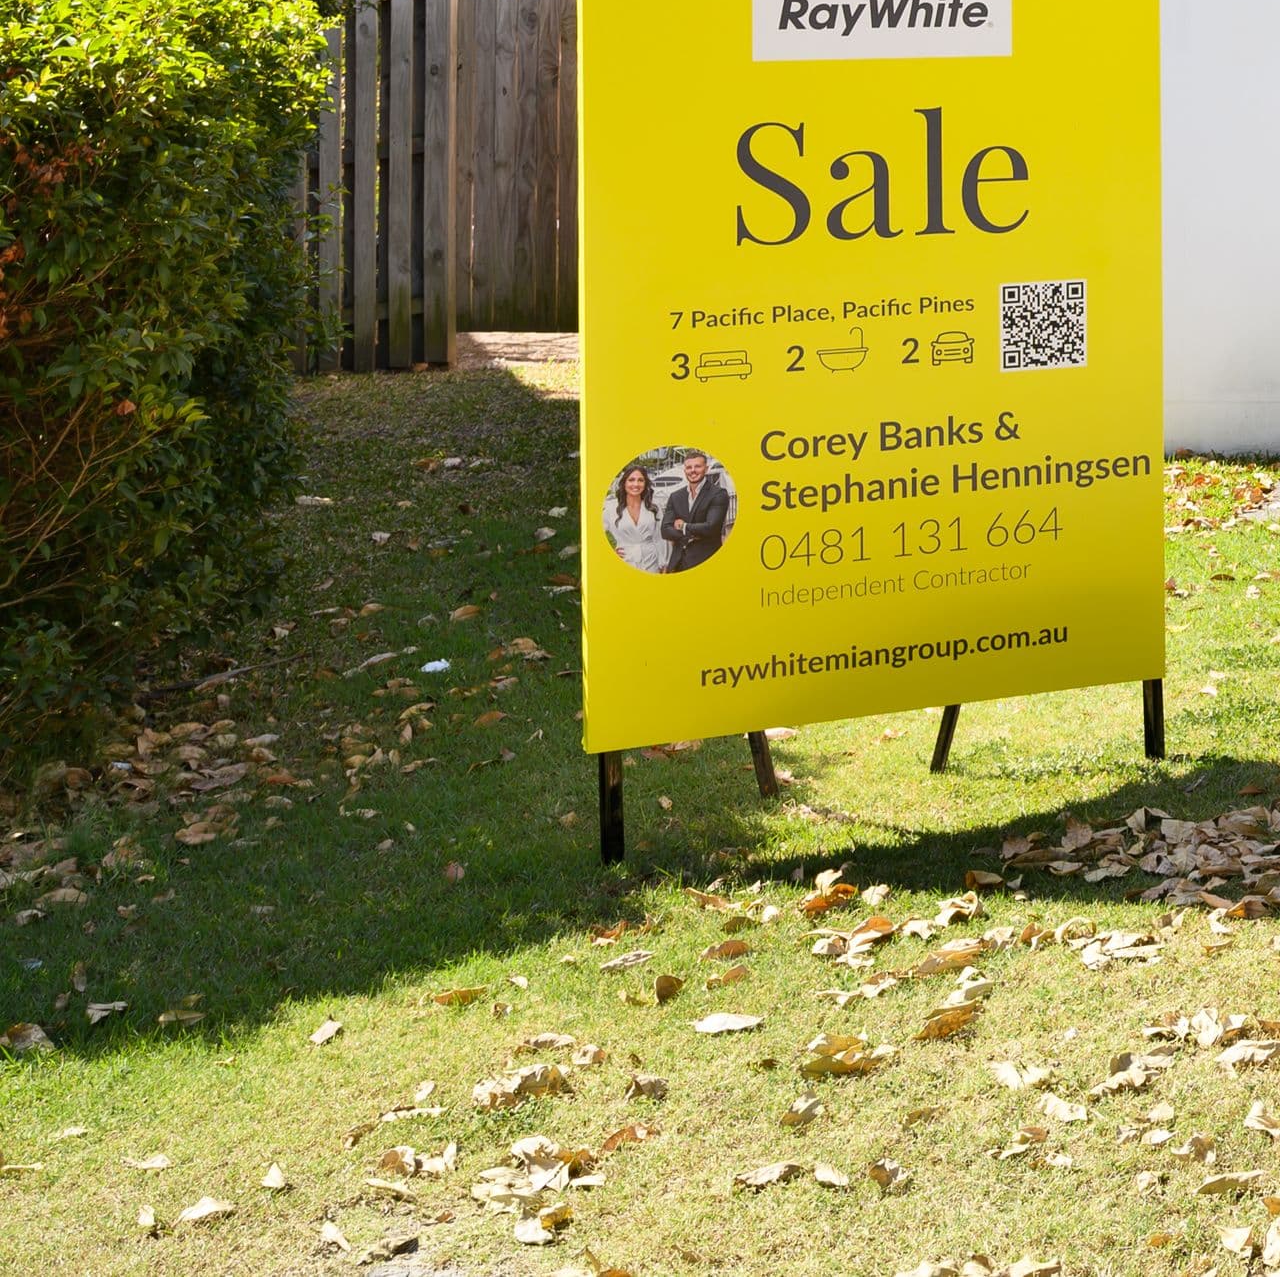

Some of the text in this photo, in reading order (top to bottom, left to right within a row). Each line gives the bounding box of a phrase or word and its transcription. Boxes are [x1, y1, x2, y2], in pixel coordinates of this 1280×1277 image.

[736, 106, 1029, 247] Sale
[669, 296, 975, 330] 7 Pacific Place, Pacific Pines
[670, 337, 920, 381] 3 2 2
[760, 411, 1021, 461] Corey Banks &
[760, 454, 1151, 513] Stephanie Henningsen
[760, 506, 1064, 571] 0481 131 664
[760, 563, 1032, 608] Independent Contractor
[701, 625, 1068, 688] raywhitemiangroup.com.au
